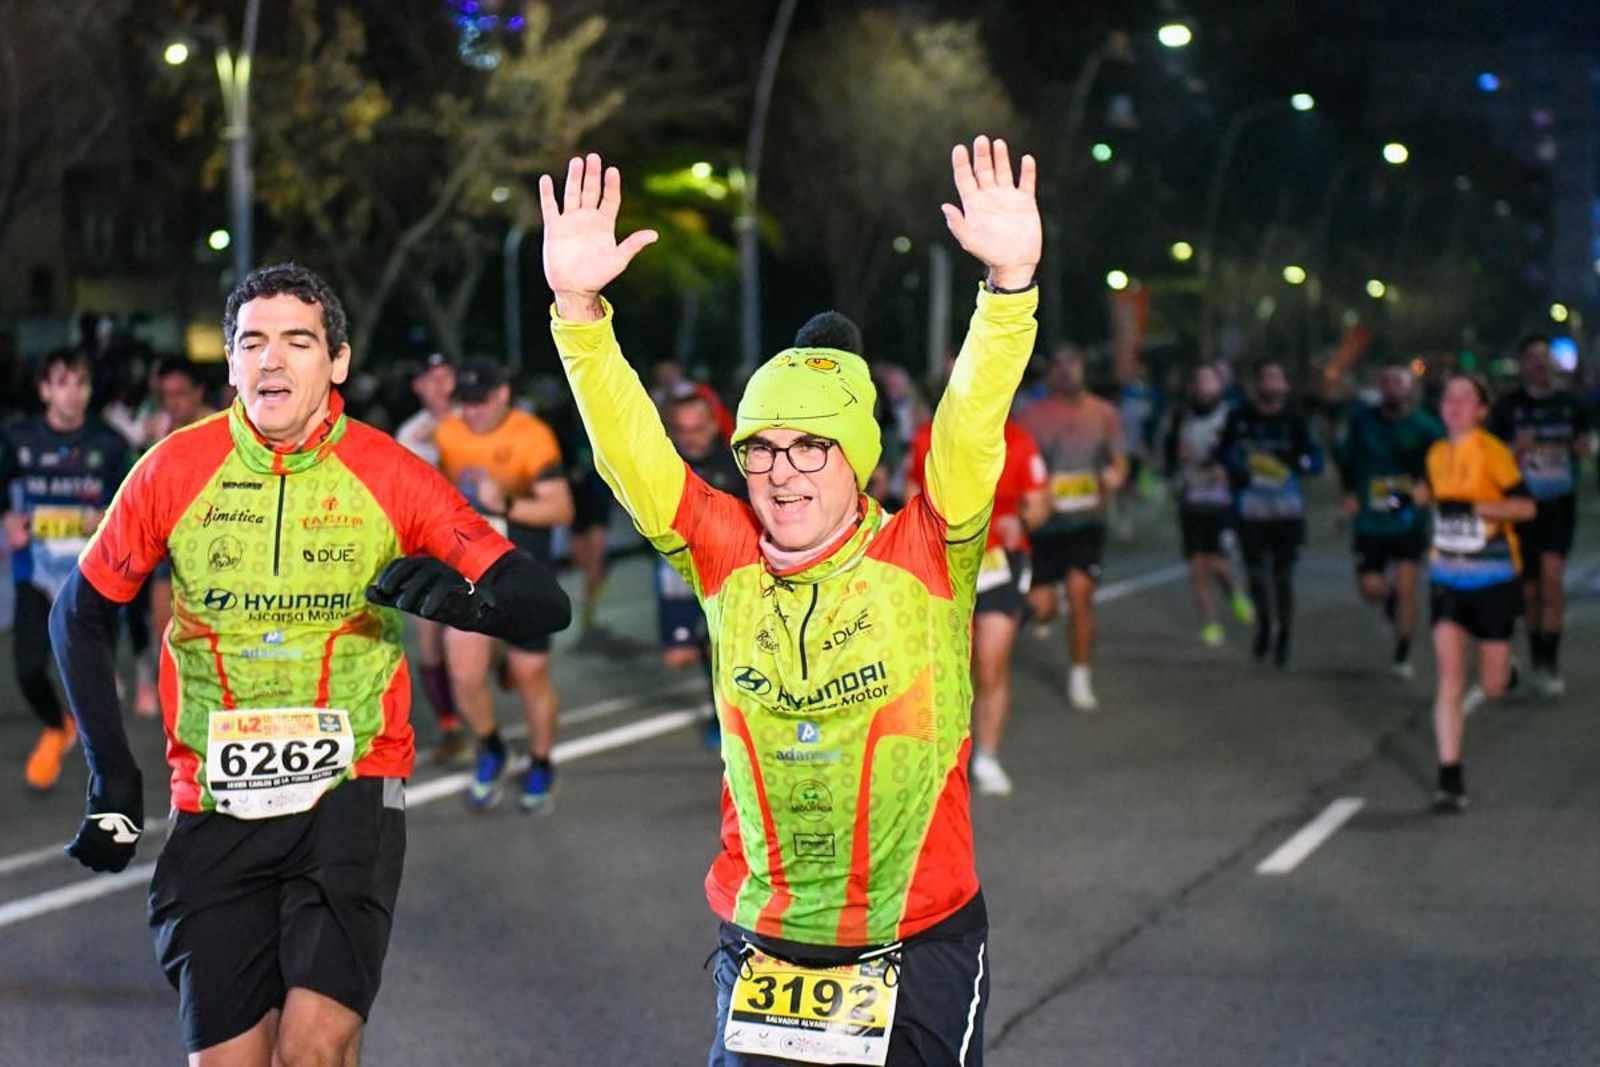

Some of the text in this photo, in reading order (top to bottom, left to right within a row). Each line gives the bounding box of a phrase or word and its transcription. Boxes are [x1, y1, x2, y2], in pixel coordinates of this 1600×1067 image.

[245, 593, 351, 610] HYUNDAI
[777, 661, 886, 709] HYUNDAI
[841, 685, 888, 707] Motor
[220, 739, 340, 777] 6262
[747, 976, 878, 1023] 3192
[766, 1015, 800, 1026] SALVADOR
